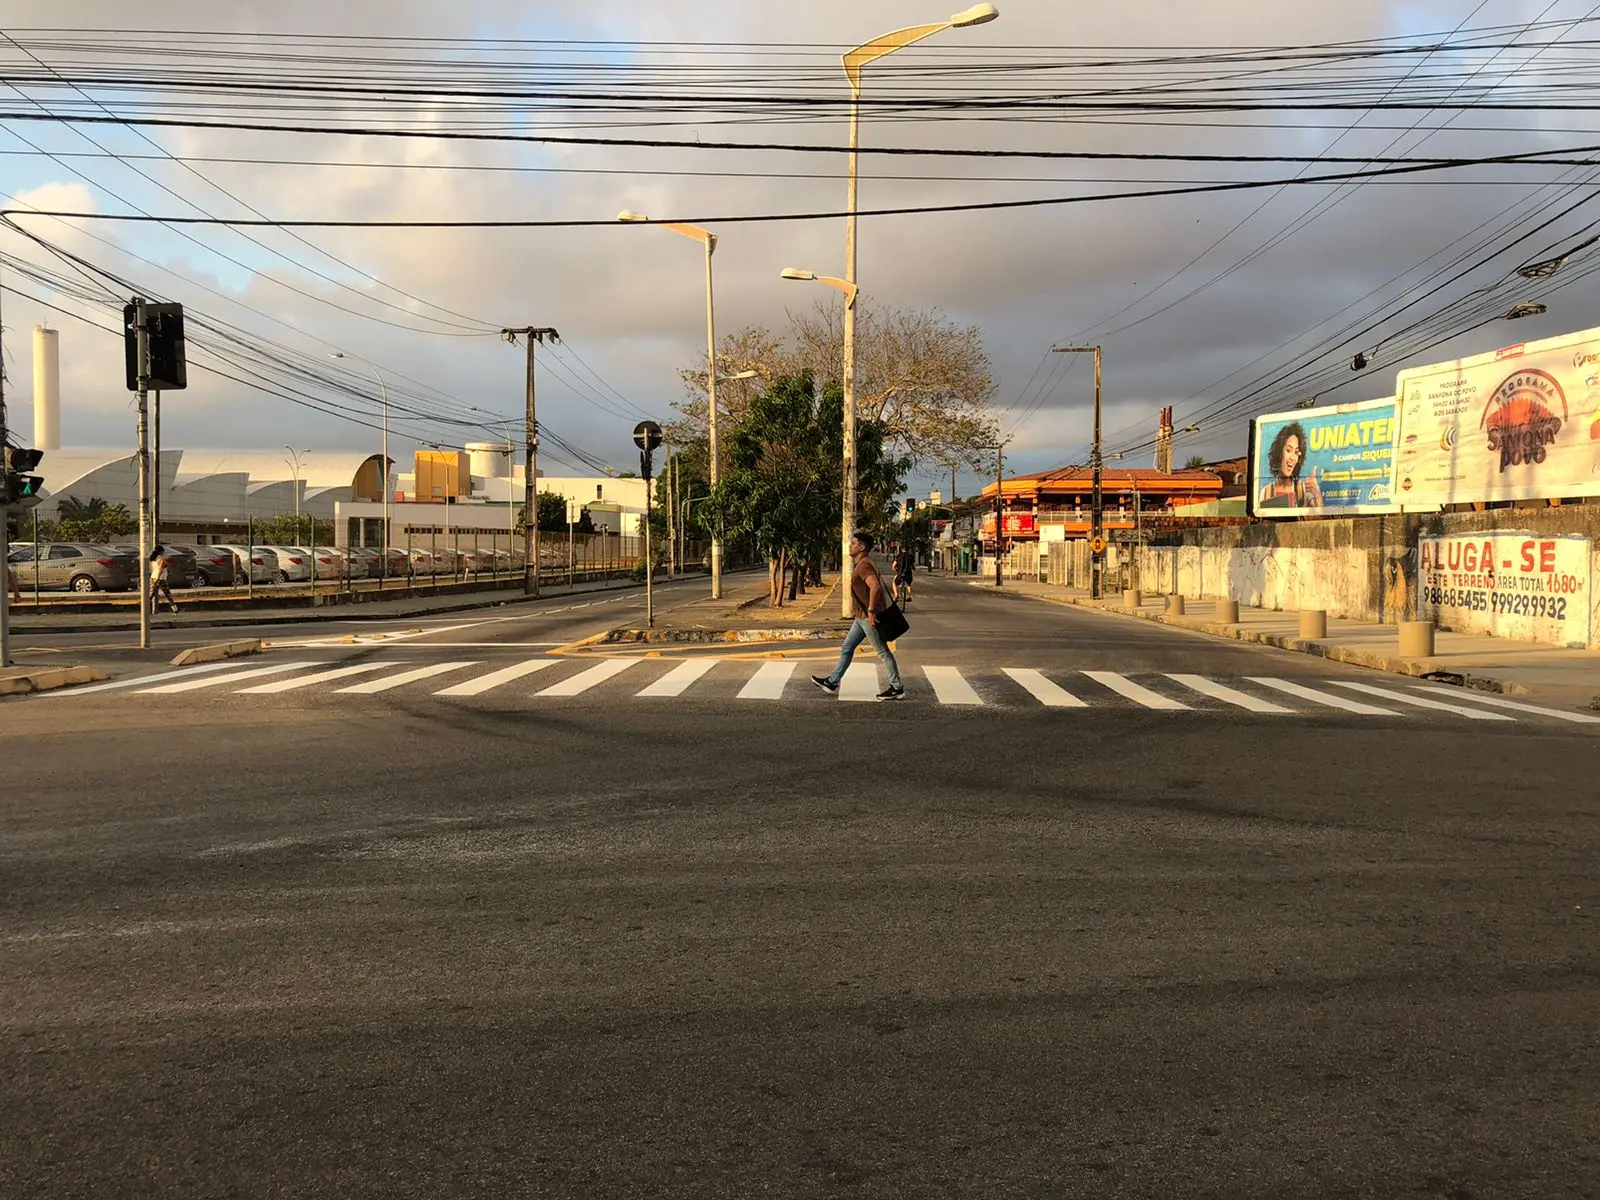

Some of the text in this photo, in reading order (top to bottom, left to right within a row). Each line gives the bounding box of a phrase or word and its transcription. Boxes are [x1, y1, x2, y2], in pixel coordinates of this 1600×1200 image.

[1495, 376, 1555, 404] PROGRAMA
[1338, 453, 1361, 462] CAMPUS
[1420, 541, 1495, 573] ALUGA
[1427, 573, 1448, 586] ESTE
[1452, 573, 1496, 589] TERRENO
[1521, 576, 1545, 592] TOTAL
[1423, 586, 1487, 612] 988685455
